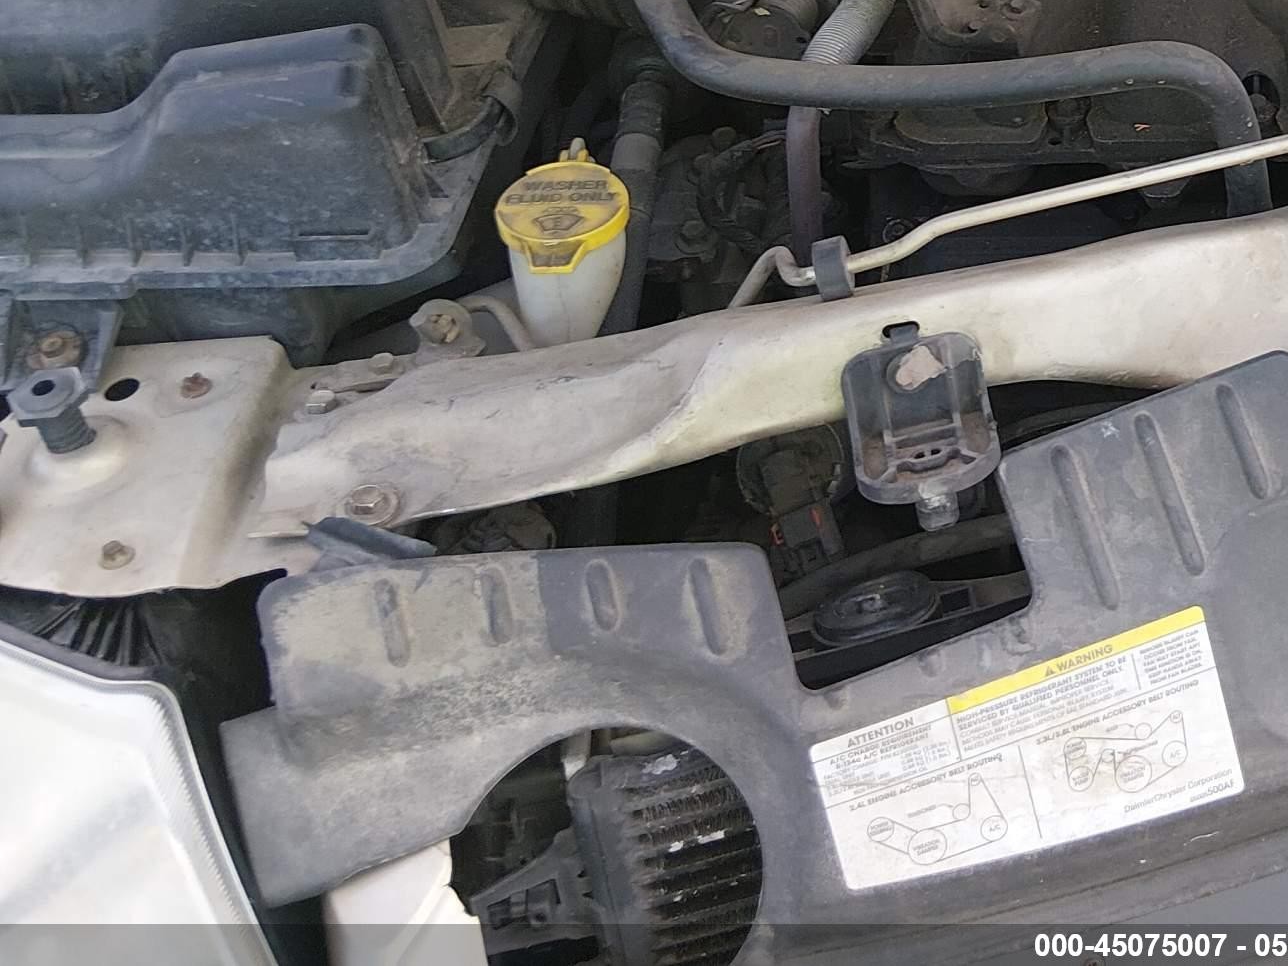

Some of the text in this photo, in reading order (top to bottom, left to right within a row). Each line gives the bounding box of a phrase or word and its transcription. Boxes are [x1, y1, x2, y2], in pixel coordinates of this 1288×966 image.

[506, 192, 617, 204] FLUID ONLY
[525, 180, 608, 191] WASHER
[1058, 645, 1113, 672] WARNING
[957, 697, 1018, 724] HIGH-PRESSURE
[1020, 677, 1072, 700] REFRIGERANT
[1075, 665, 1104, 680] SYSTEM
[1106, 661, 1116, 669] TO
[959, 713, 998, 731] SERVICED
[1000, 708, 1009, 716] BY
[1012, 692, 1053, 712] QUALIFIED
[1056, 675, 1100, 696] PERSONNEL
[1073, 718, 1100, 732] ENGINE
[1103, 699, 1147, 720] ACCESSORY
[1149, 693, 1164, 703] BELT
[1166, 680, 1199, 697] ROUTING
[847, 717, 914, 748] ATTENTION
[868, 791, 897, 805] ENGINE
[899, 774, 947, 794] ACCESSORY
[949, 767, 966, 778] BELT
[967, 754, 1003, 772] ROUTING
[1123, 769, 1234, 813] DaimlerChrysler Corporation
[989, 825, 1002, 833] A/C
